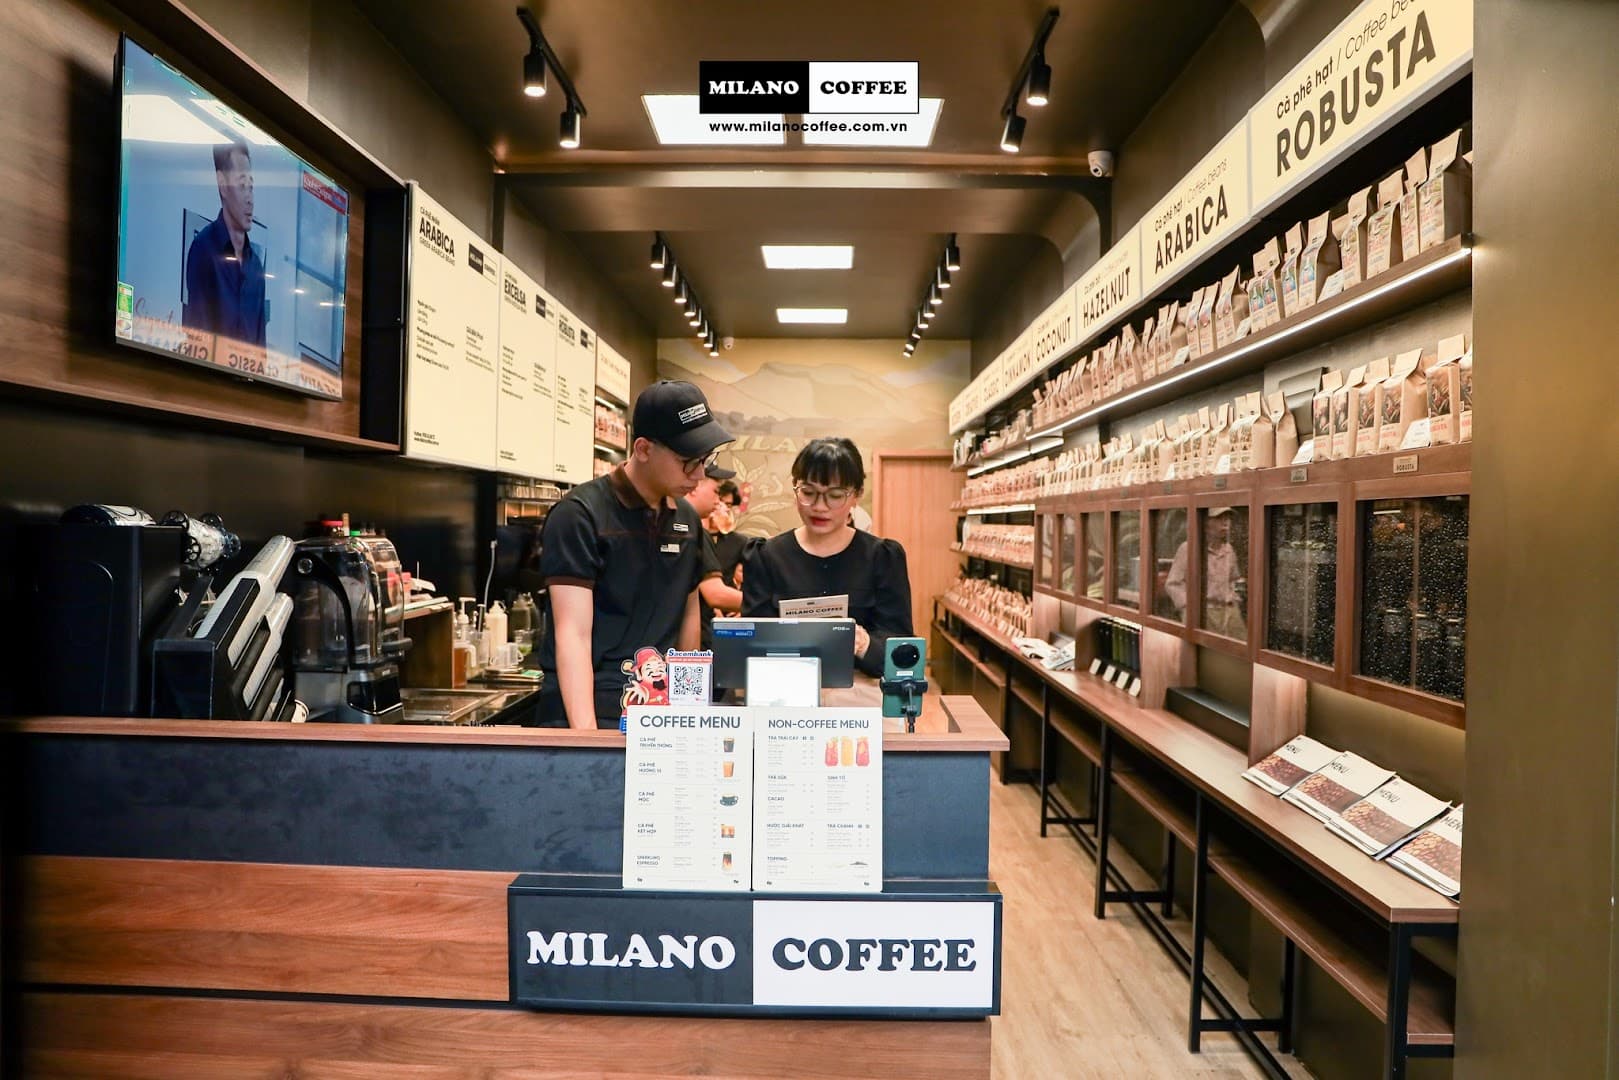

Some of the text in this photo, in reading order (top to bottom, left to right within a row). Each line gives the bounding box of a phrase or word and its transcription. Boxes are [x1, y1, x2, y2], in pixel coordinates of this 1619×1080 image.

[1276, 95, 1291, 119] Cà
[1293, 76, 1312, 111] phê
[1315, 56, 1333, 86] hạt
[1345, 12, 1387, 59] Coffee
[1390, 0, 1414, 20] be
[1277, 10, 1436, 177] ROBUSTA
[419, 216, 455, 257] ARABICA
[1155, 184, 1228, 274] ARABICA
[1083, 267, 1130, 328] HAZELNUT
[1035, 316, 1070, 362] COCONUT
[669, 649, 711, 657] Sacombank
[640, 715, 741, 729] COFFEE MENU
[768, 719, 869, 729] NON-COFFEE MENU
[1330, 761, 1349, 774] MENU
[1379, 789, 1401, 803] MENU
[526, 931, 977, 972] MILANO COFFEE
